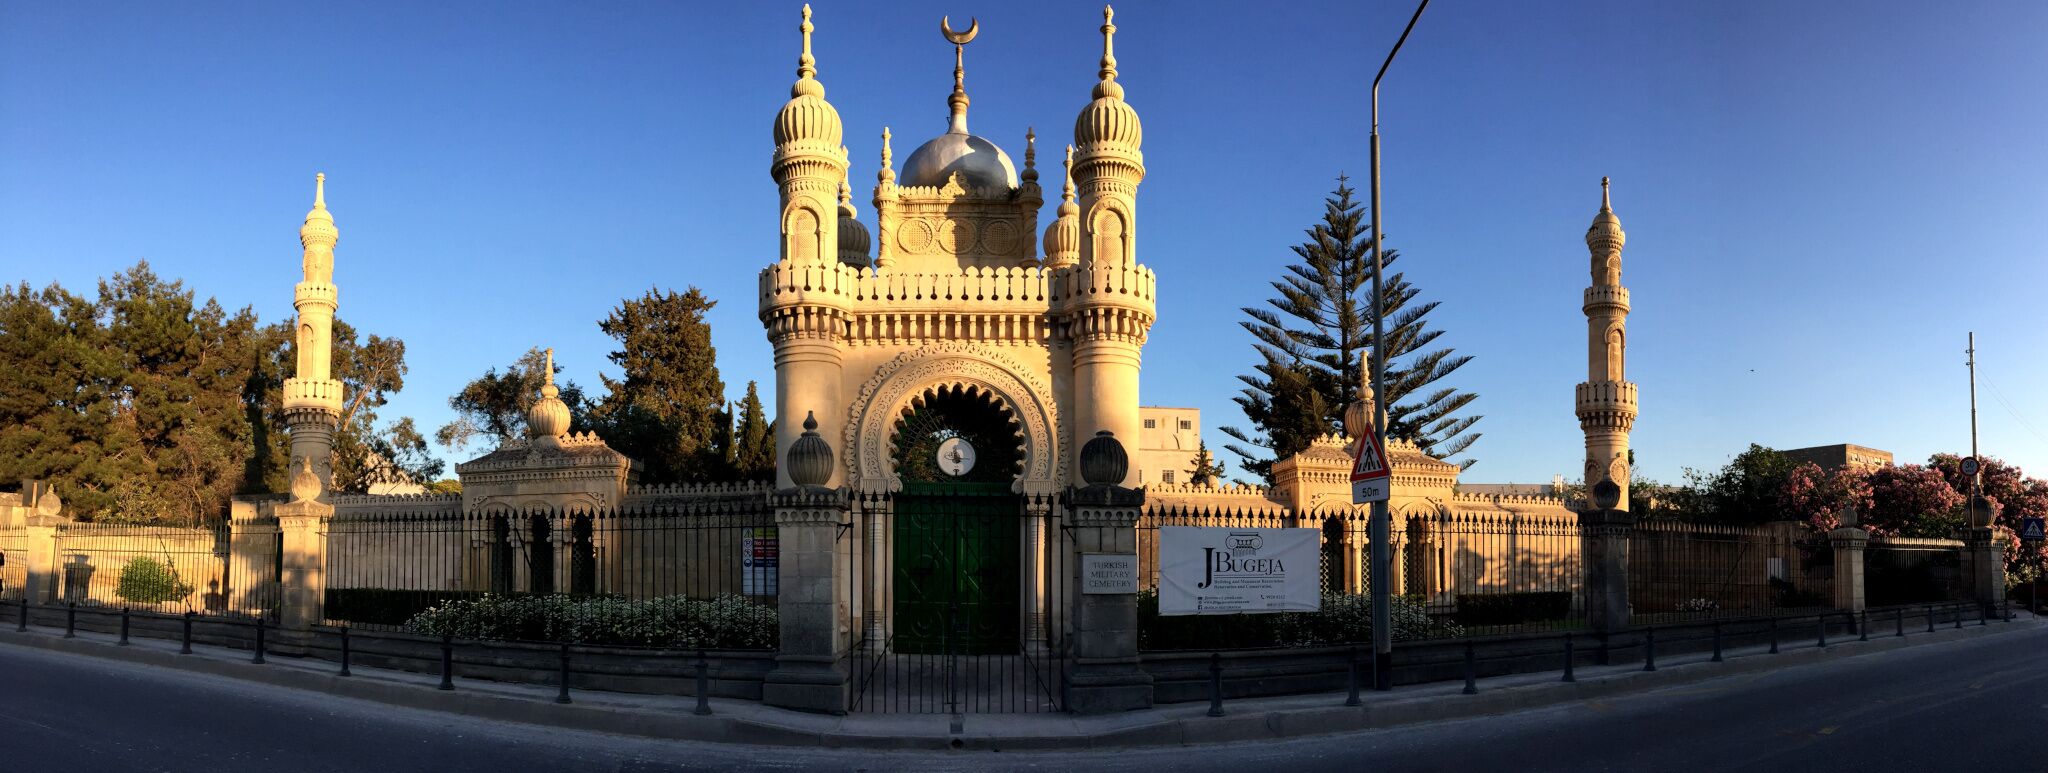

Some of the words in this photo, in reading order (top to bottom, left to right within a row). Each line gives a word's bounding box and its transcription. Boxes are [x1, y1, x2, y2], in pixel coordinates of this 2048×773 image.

[1965, 461, 1975, 469] 30
[1362, 487, 1380, 498] 50m
[1092, 561, 1128, 569] TURKISH
[1089, 580, 1131, 588] CEMETERY
